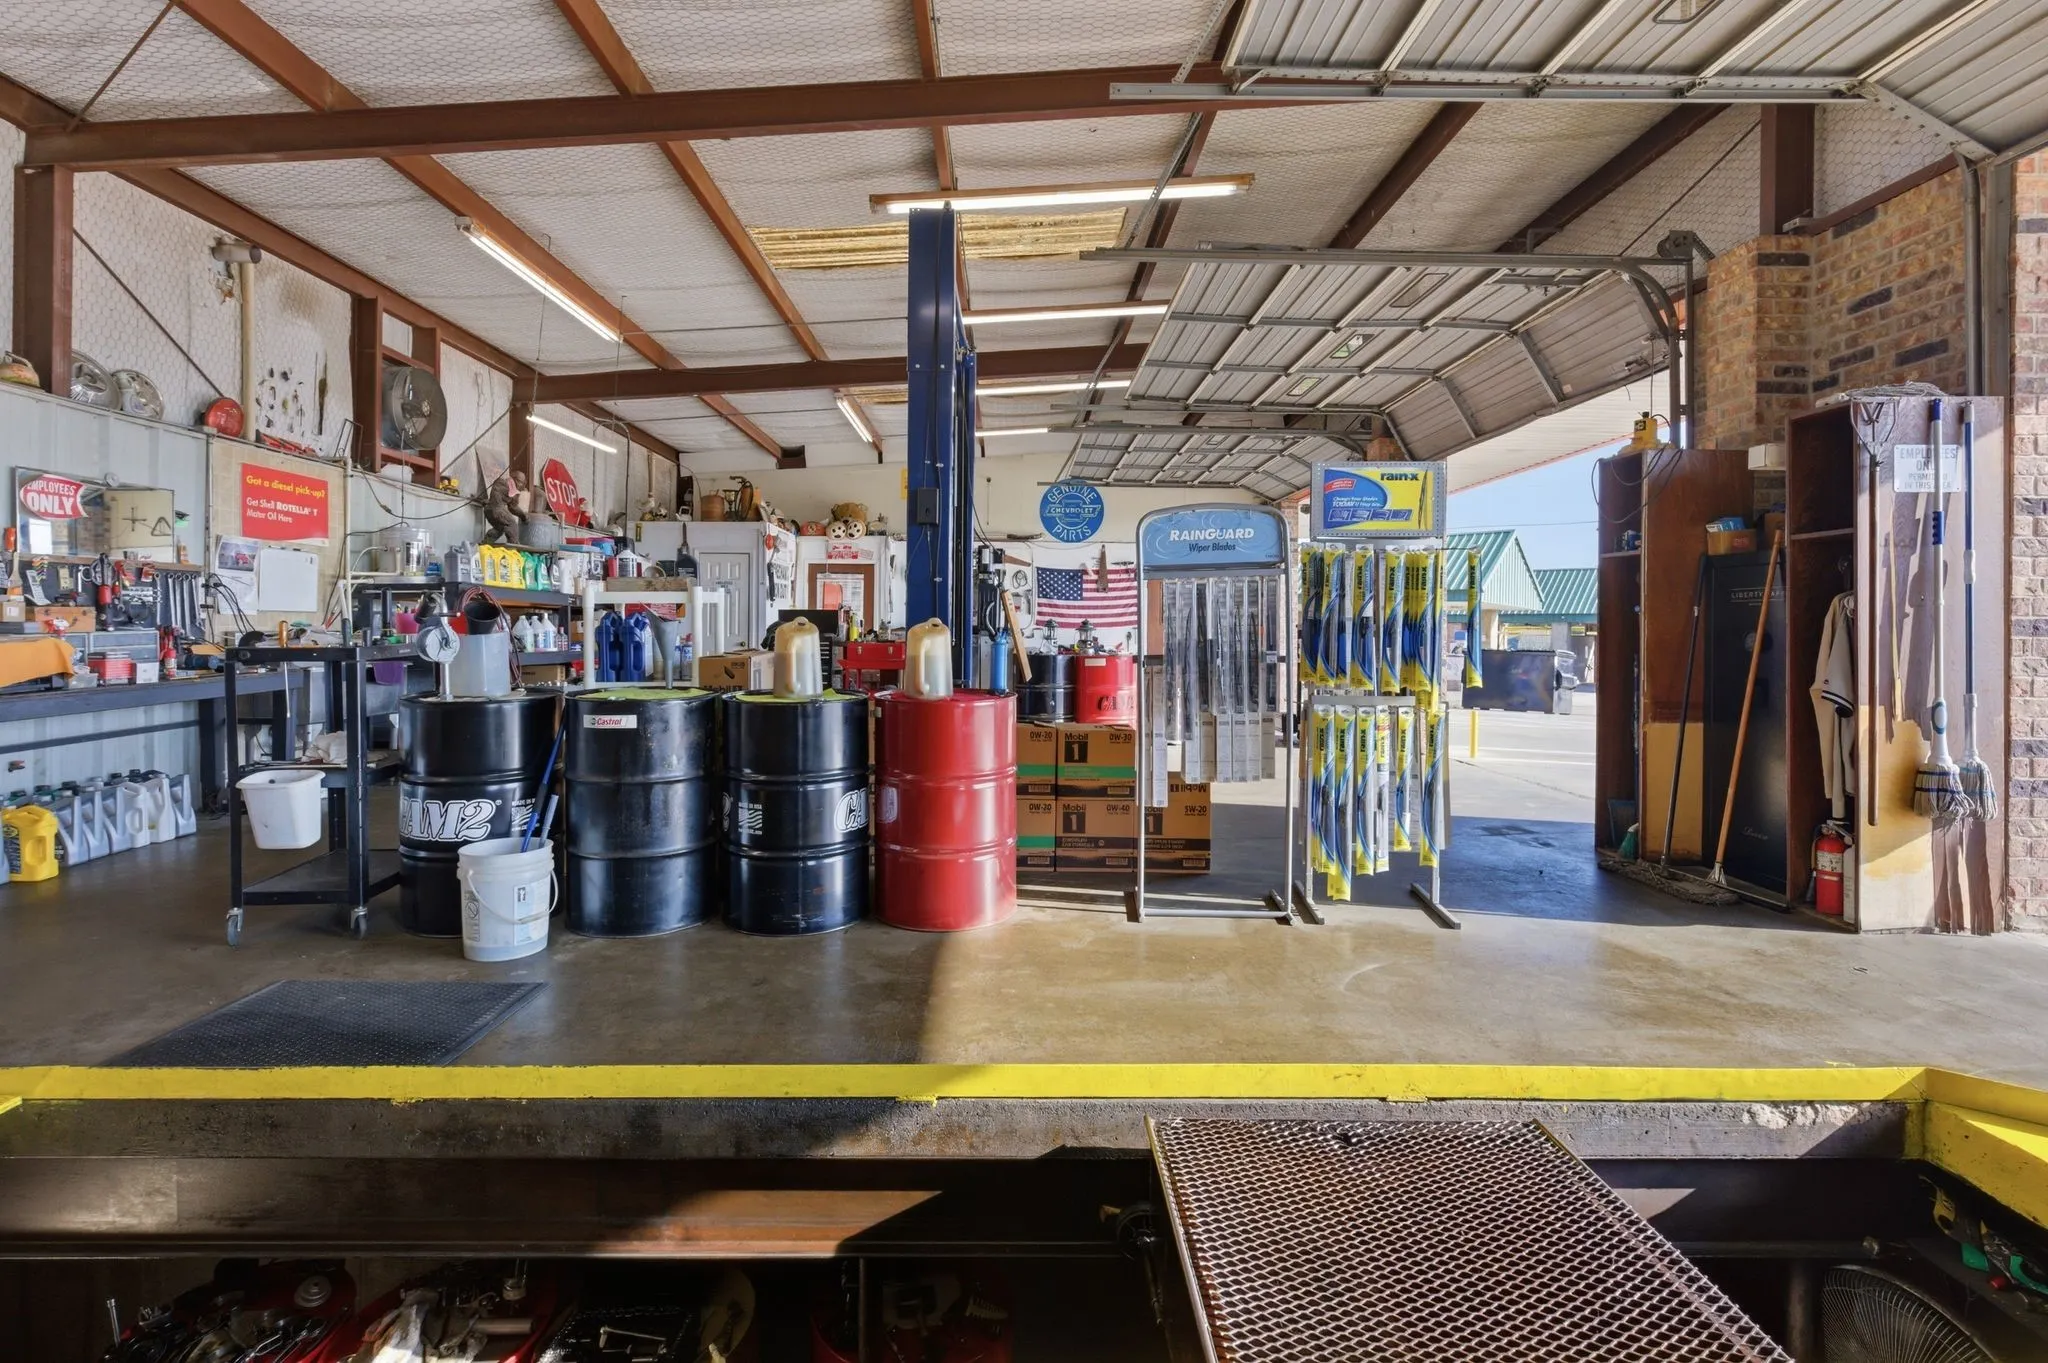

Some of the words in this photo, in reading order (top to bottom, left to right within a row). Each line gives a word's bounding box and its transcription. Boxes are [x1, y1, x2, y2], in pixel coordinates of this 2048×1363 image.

[1900, 448, 1956, 459] EMPLOES
[26, 480, 76, 496] EMPLOYEES
[246, 475, 261, 485] Got
[271, 481, 293, 492] diesel
[295, 485, 325, 499] pick-up?
[547, 477, 577, 507] STOP
[1047, 485, 1097, 503] GENUINE
[27, 492, 75, 515] ONLY
[246, 497, 258, 506] Get
[1052, 525, 1091, 541] PARTS
[1170, 528, 1255, 541] RAINGUARD
[1189, 543, 1210, 553] Wiper
[1212, 542, 1236, 551] Blades
[597, 718, 622, 726] Castrol
[1030, 731, 1053, 739] 0W-20
